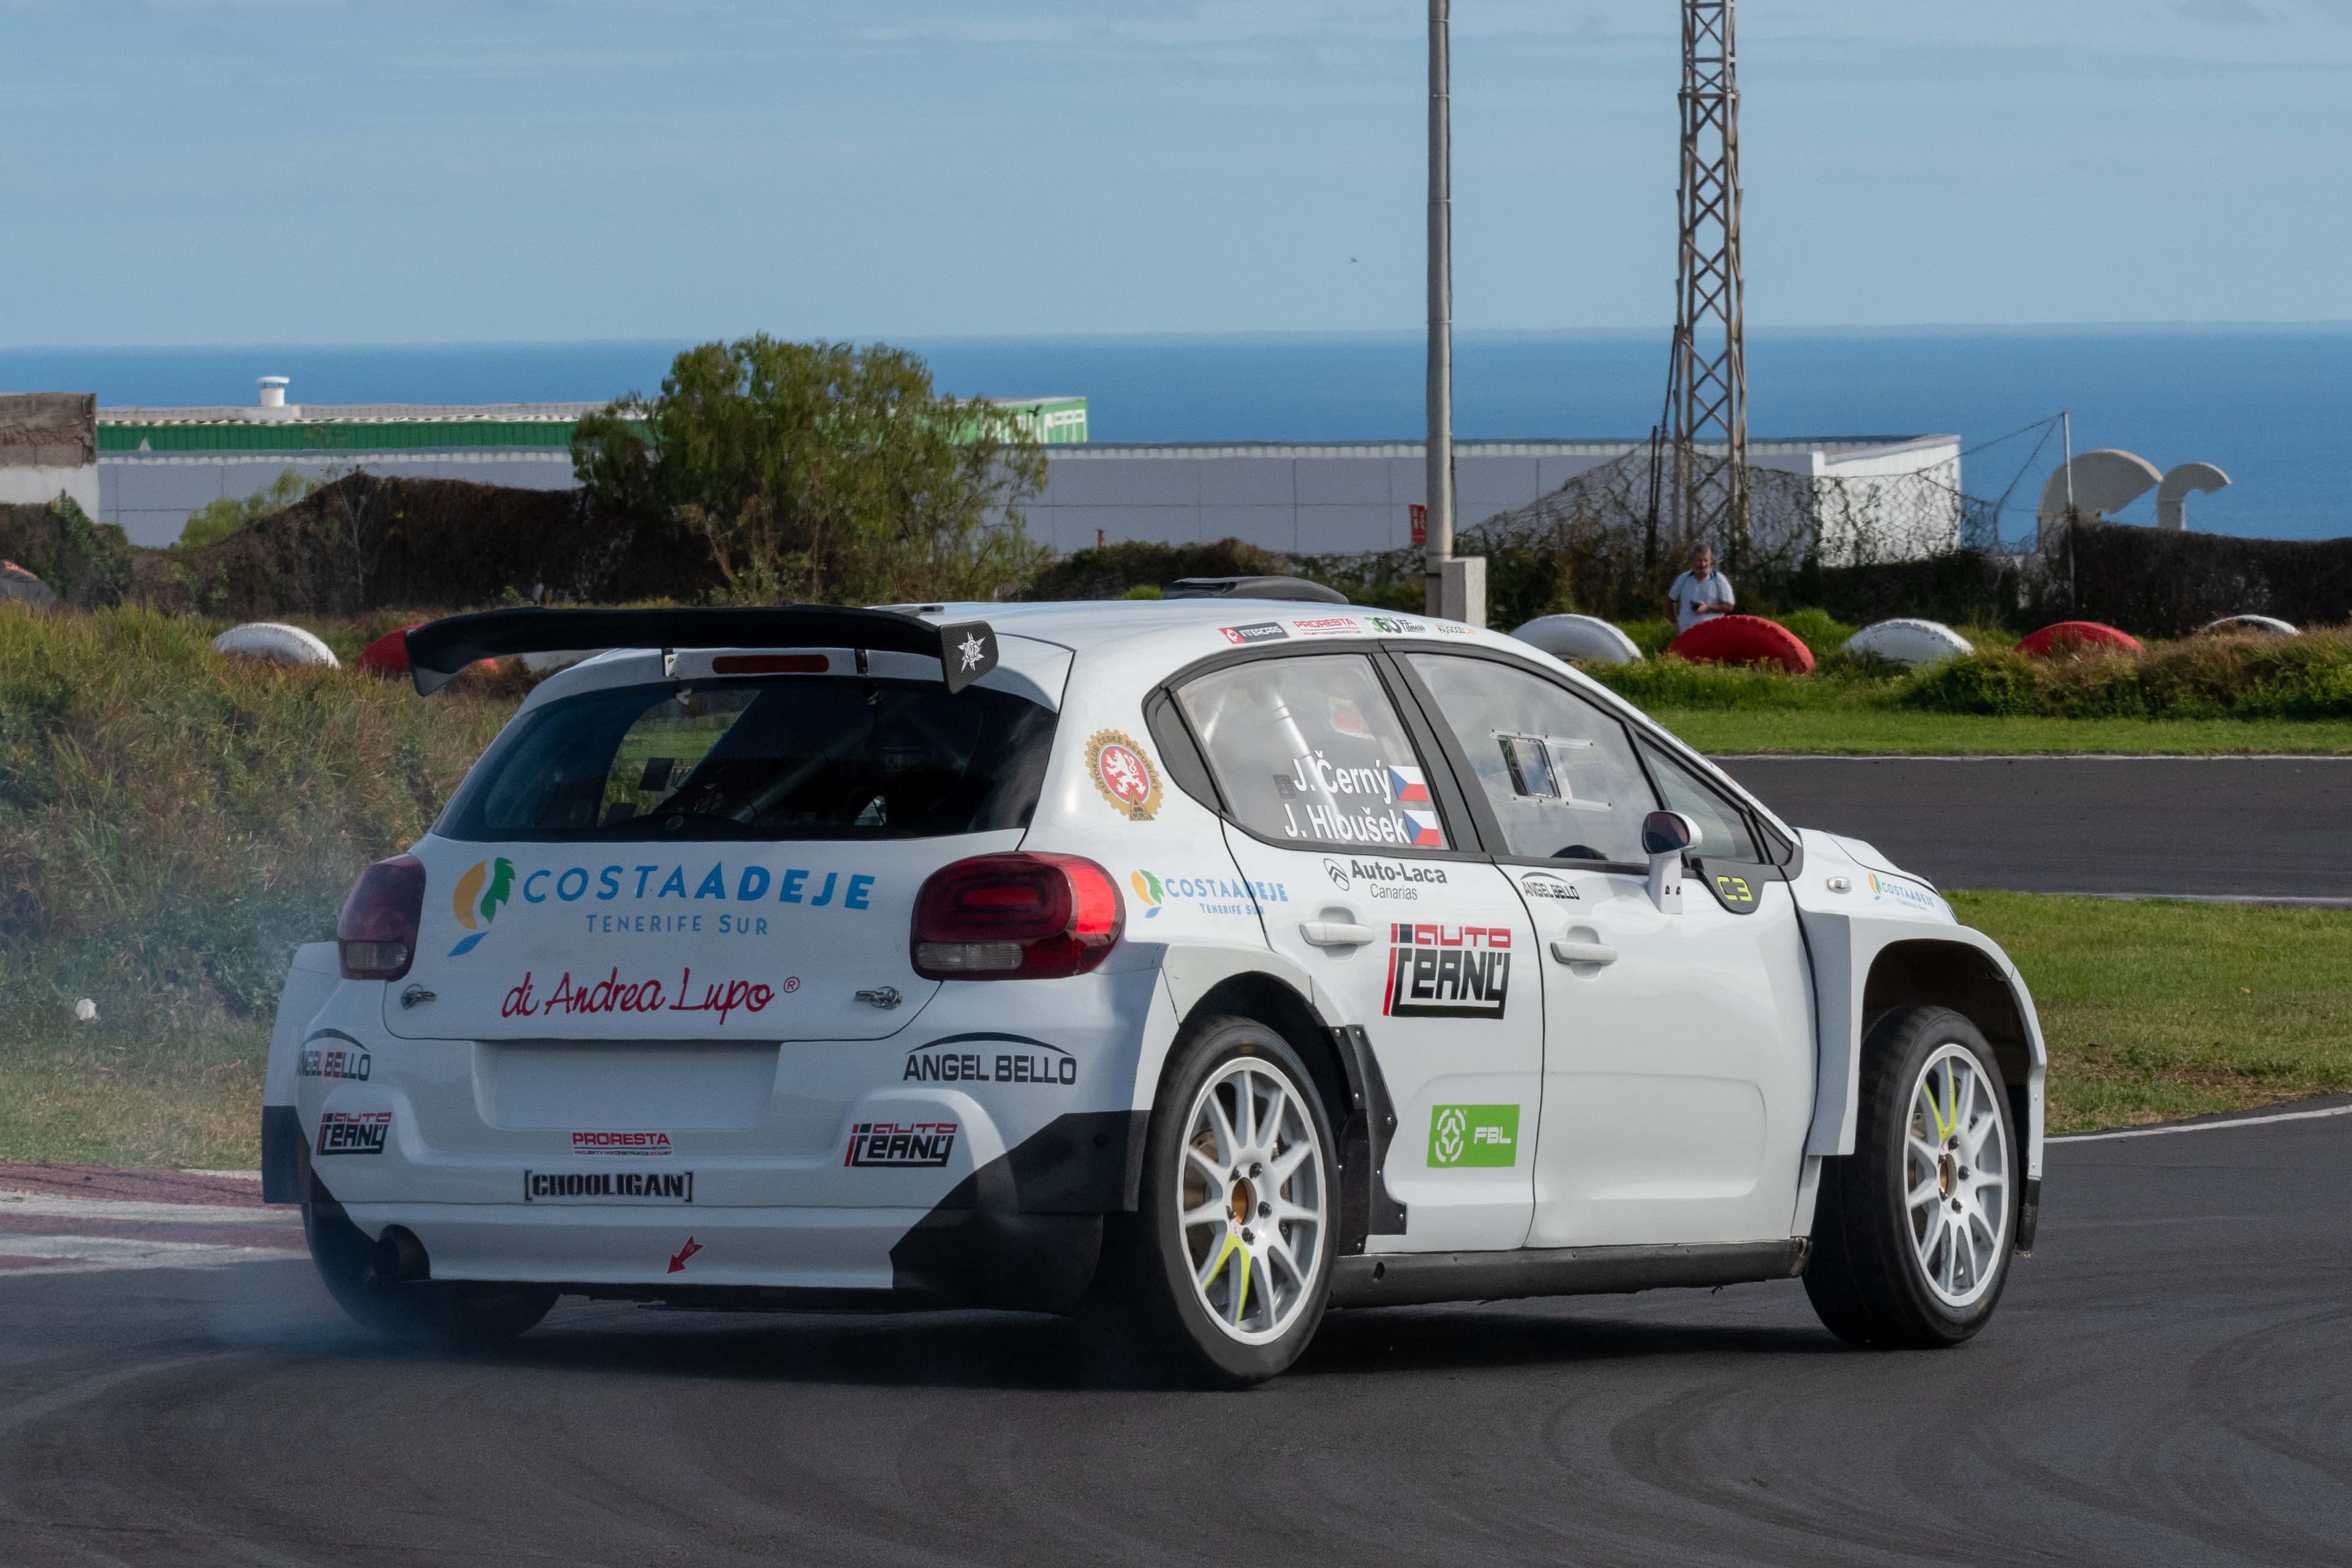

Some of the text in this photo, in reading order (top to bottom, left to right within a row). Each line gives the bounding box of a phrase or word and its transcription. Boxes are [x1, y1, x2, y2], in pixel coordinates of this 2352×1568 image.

[1292, 617, 1357, 628] PRORESTA
[1091, 735, 1159, 794] AUTOKLUB ČESKÉ REPUBLIKY
[1292, 759, 1315, 791] J.
[1314, 750, 1392, 804] Černý
[1283, 803, 1412, 844] J. Hloušek
[1351, 859, 1447, 884] Auto-Laca
[524, 861, 875, 910] COSTAADEJE
[1165, 878, 1289, 902] COSTAADEJE
[1370, 883, 1418, 900] Canarias
[1522, 881, 1580, 900] ANGEL BELLO
[1200, 903, 1242, 914] TENERIFE
[586, 914, 768, 935] TENERIFE SUR
[1415, 923, 1511, 948] AUTO
[502, 971, 540, 1019] di
[544, 967, 665, 1015] Andrea
[669, 967, 775, 1025] Lupo
[324, 1052, 371, 1082] BELLO
[903, 1054, 1077, 1085] ANGEL BELLO
[334, 1112, 393, 1123] AUTO
[872, 1123, 958, 1134] AUTO
[571, 1132, 671, 1145] PRORESTA
[1474, 1126, 1512, 1145] FBL
